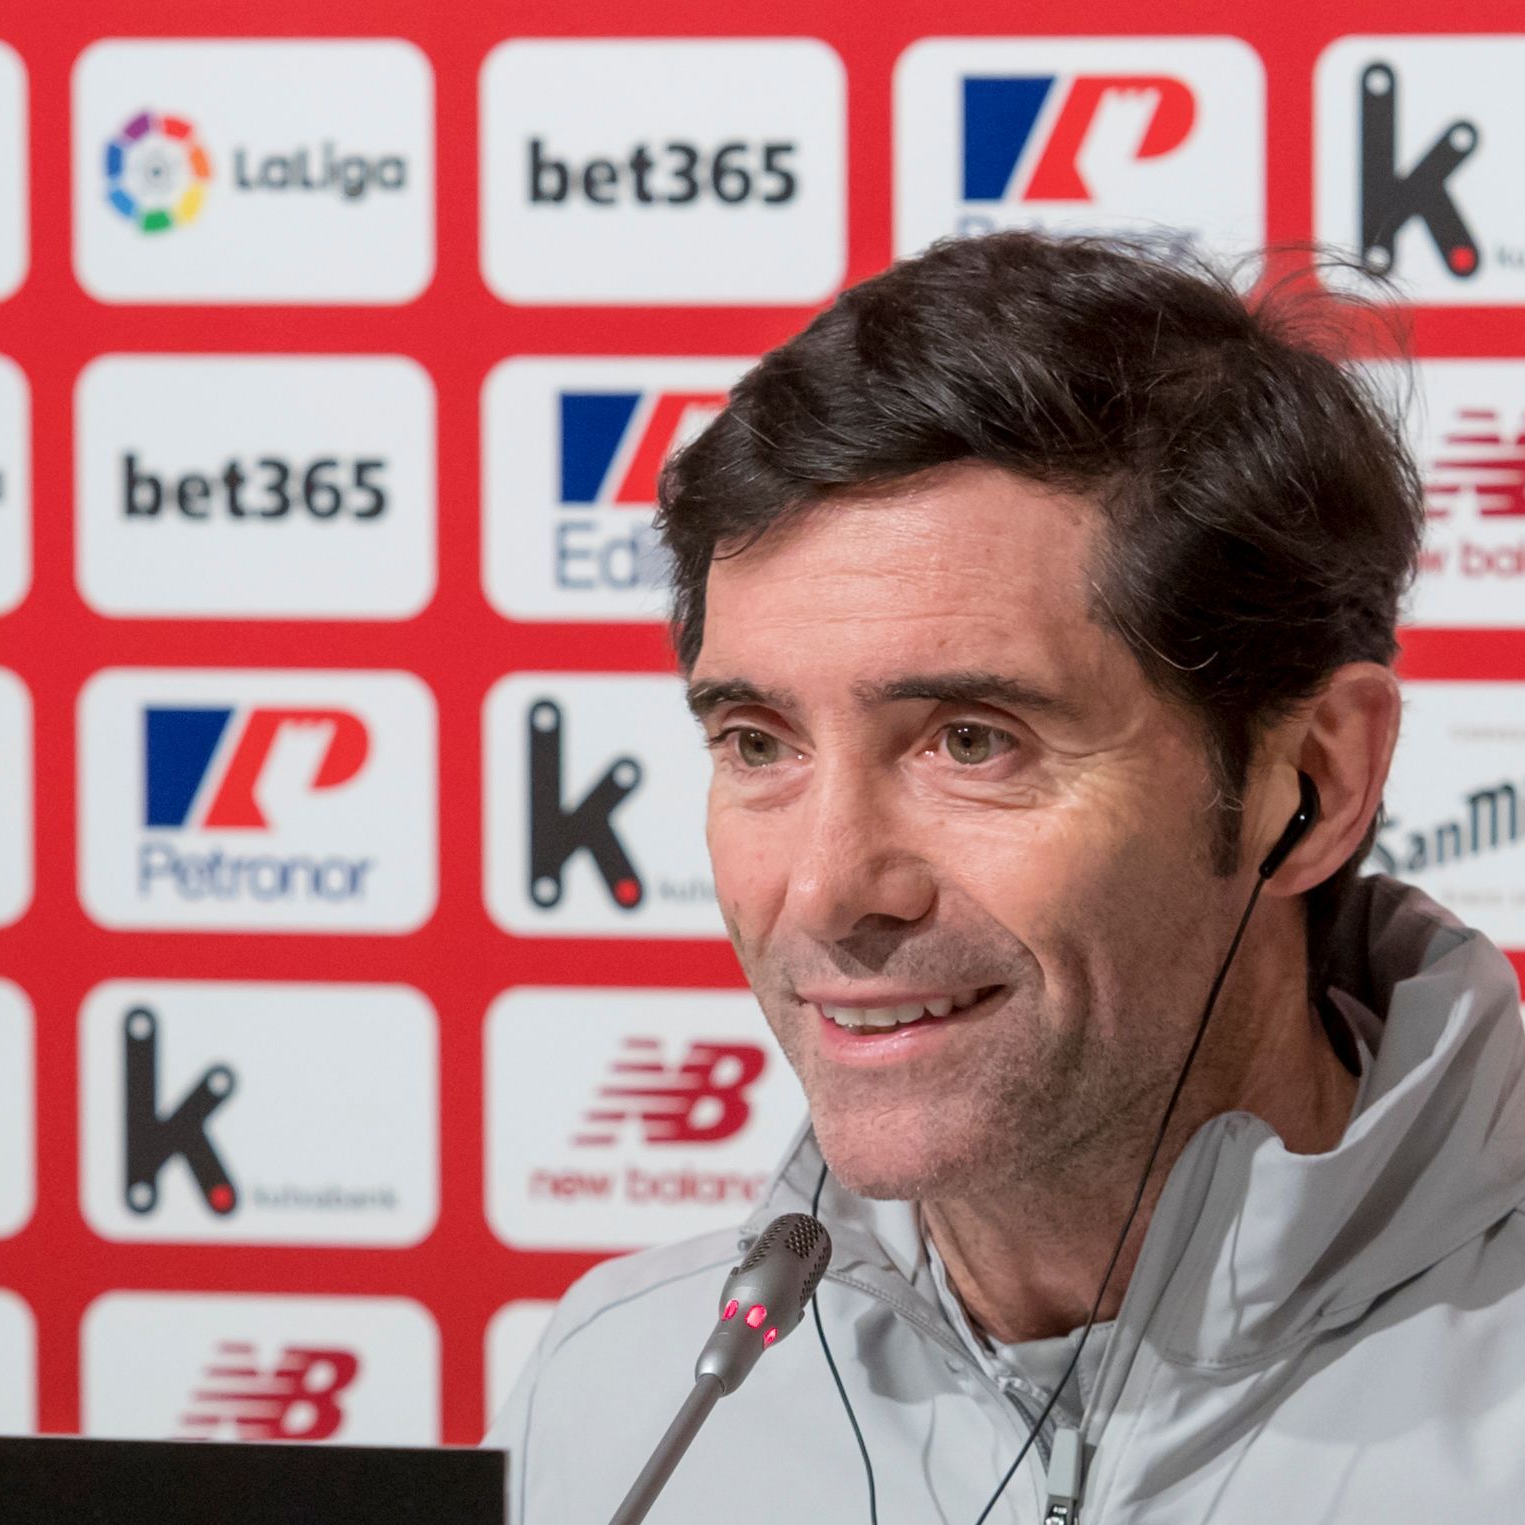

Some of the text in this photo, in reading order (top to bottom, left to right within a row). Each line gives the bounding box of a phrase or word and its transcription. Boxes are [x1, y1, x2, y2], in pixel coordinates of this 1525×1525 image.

[233, 143, 408, 204] LaLiga
[527, 137, 799, 207] bet365
[122, 451, 389, 522] bet365
[138, 838, 372, 902] Petronor
[527, 1159, 767, 1204] new balan
